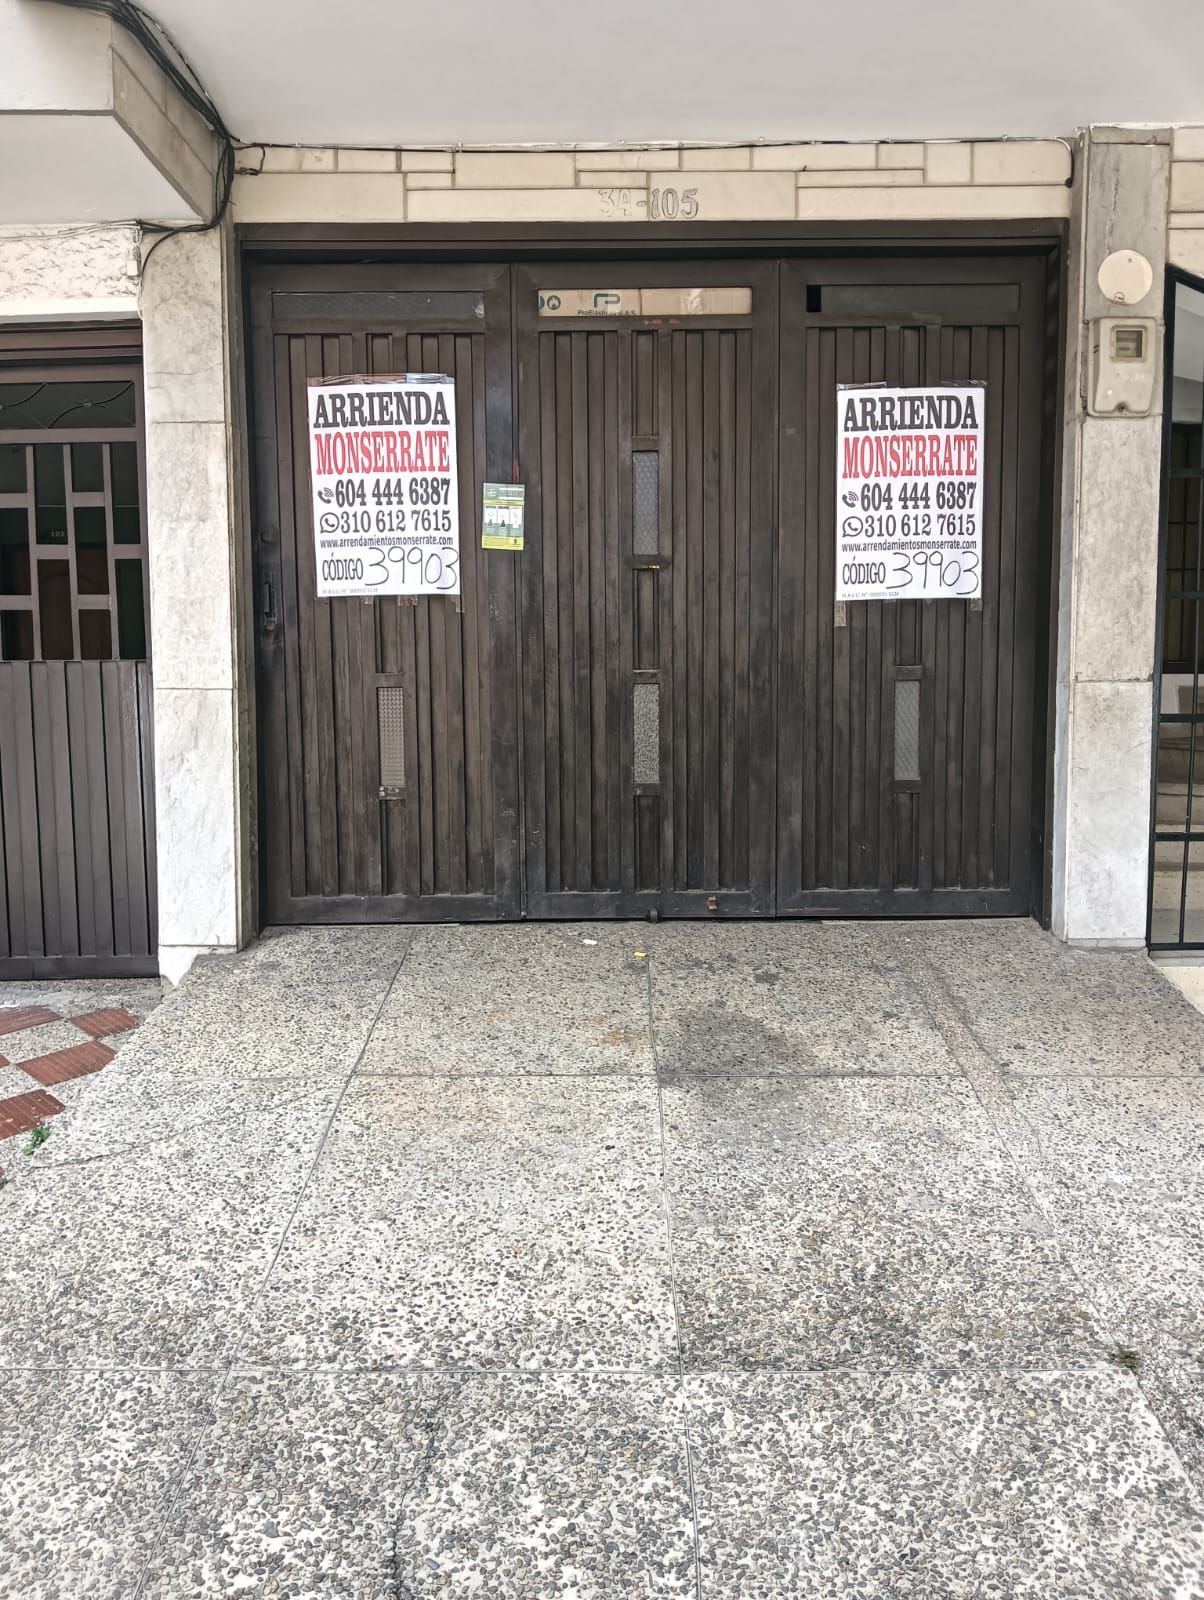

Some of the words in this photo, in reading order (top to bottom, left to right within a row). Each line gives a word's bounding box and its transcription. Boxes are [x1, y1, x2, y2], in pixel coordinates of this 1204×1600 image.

[313, 392, 450, 428] ARRIENDA
[844, 396, 978, 432] ARRIENDA
[314, 430, 450, 475] MONSERRATE
[842, 434, 977, 479] MONSERRATE
[335, 479, 366, 508] 604
[372, 478, 404, 506] 444
[409, 477, 451, 505] 6387
[860, 482, 893, 512] 604
[898, 482, 930, 510] 444
[936, 482, 977, 510] 6387
[340, 510, 371, 534] 310
[376, 509, 406, 533] 612
[410, 509, 451, 532] 7615
[865, 514, 896, 538] 310
[901, 514, 932, 536] 612
[937, 513, 976, 536] 7615
[320, 534, 453, 548] www.arrendamientosmonserrate.com
[842, 538, 977, 552] www.arrendamientosmonserrate.com
[322, 552, 364, 581] CÓDIGO
[365, 546, 459, 589] 39903
[842, 556, 886, 584] CÓDIGO
[886, 551, 980, 594] 39903
